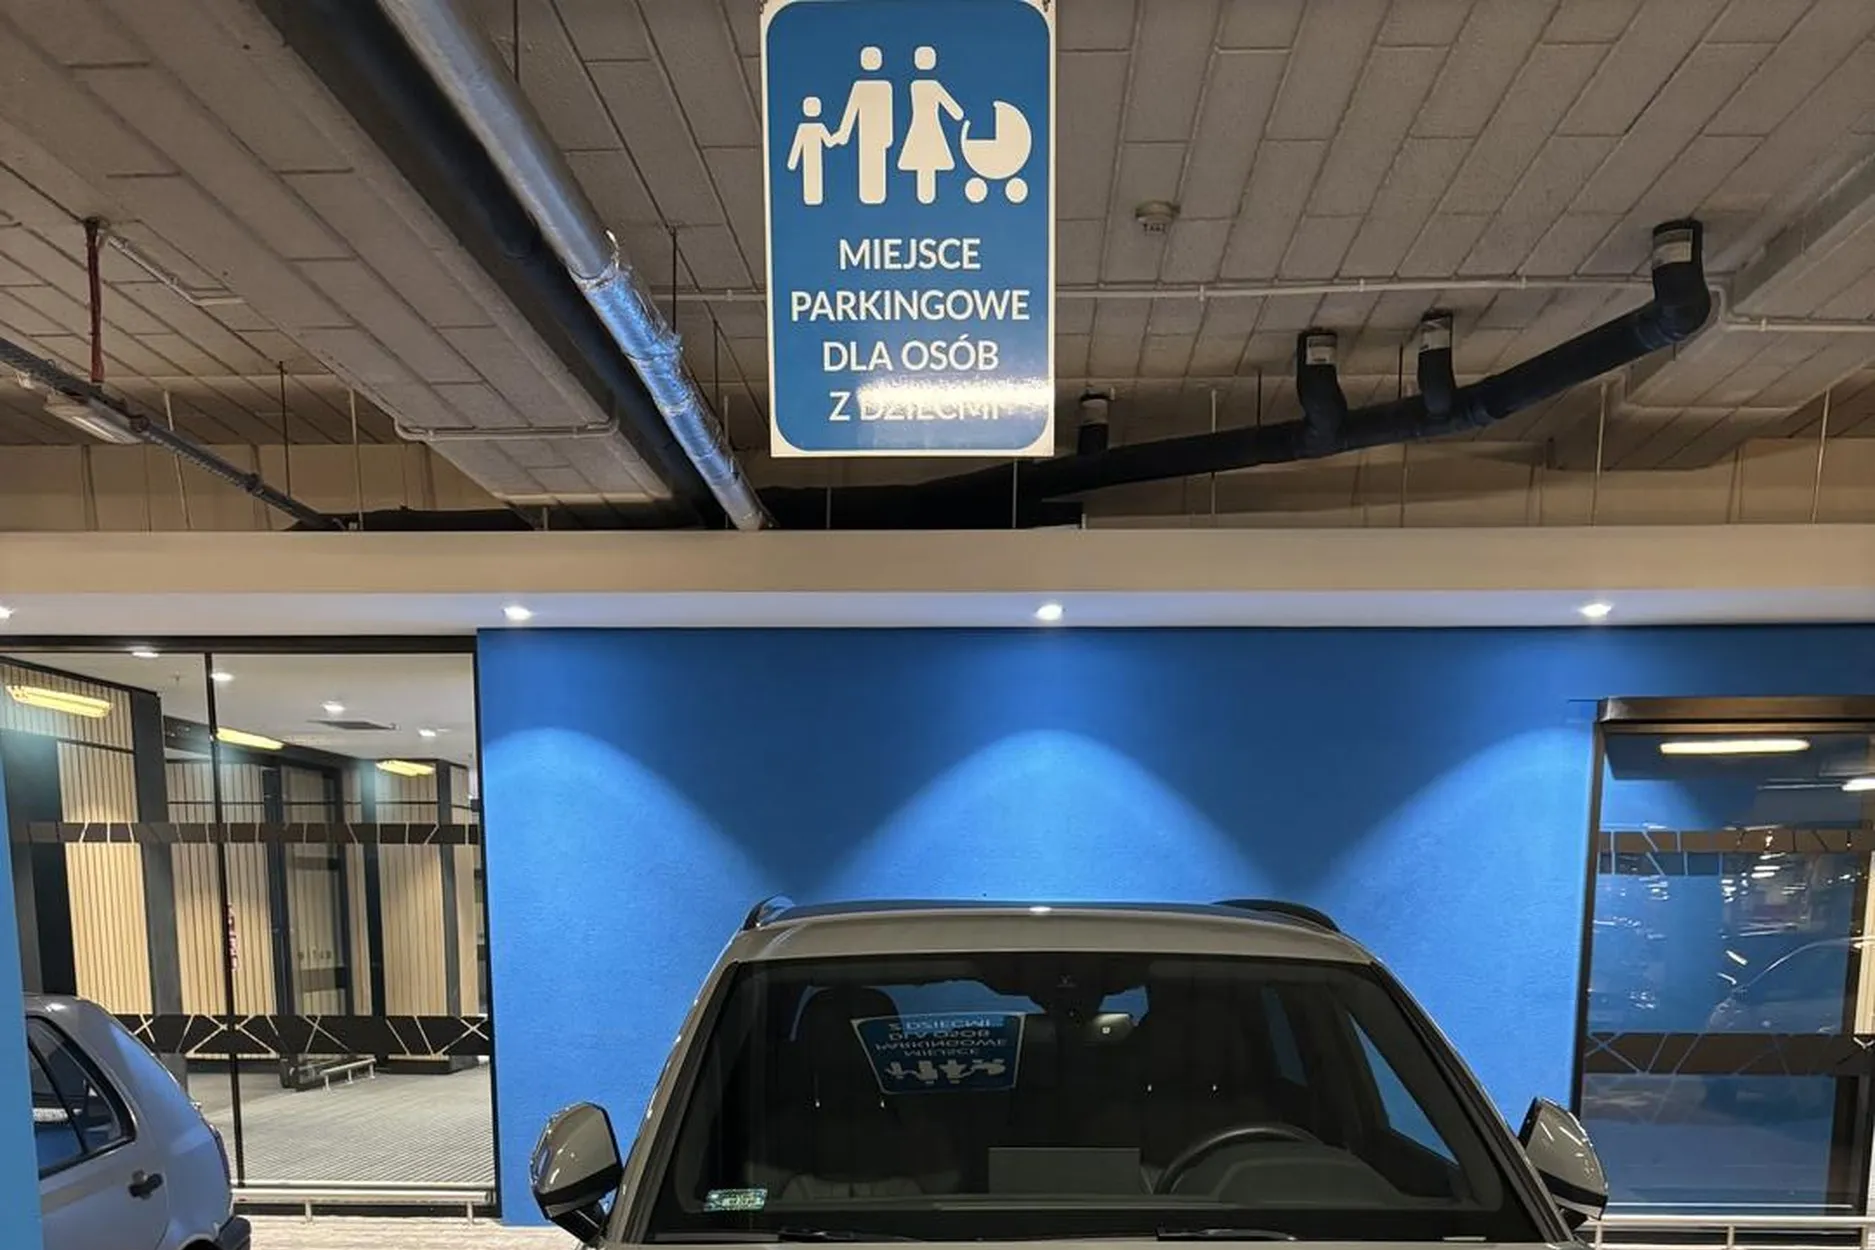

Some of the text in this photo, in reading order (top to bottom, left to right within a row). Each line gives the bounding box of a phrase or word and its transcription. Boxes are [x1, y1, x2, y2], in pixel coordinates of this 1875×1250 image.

[838, 238, 981, 270] MIEJSCE
[790, 289, 1030, 321] PARKINGOWE
[822, 333, 999, 371] DLA OSÓB
[828, 391, 850, 421] Z
